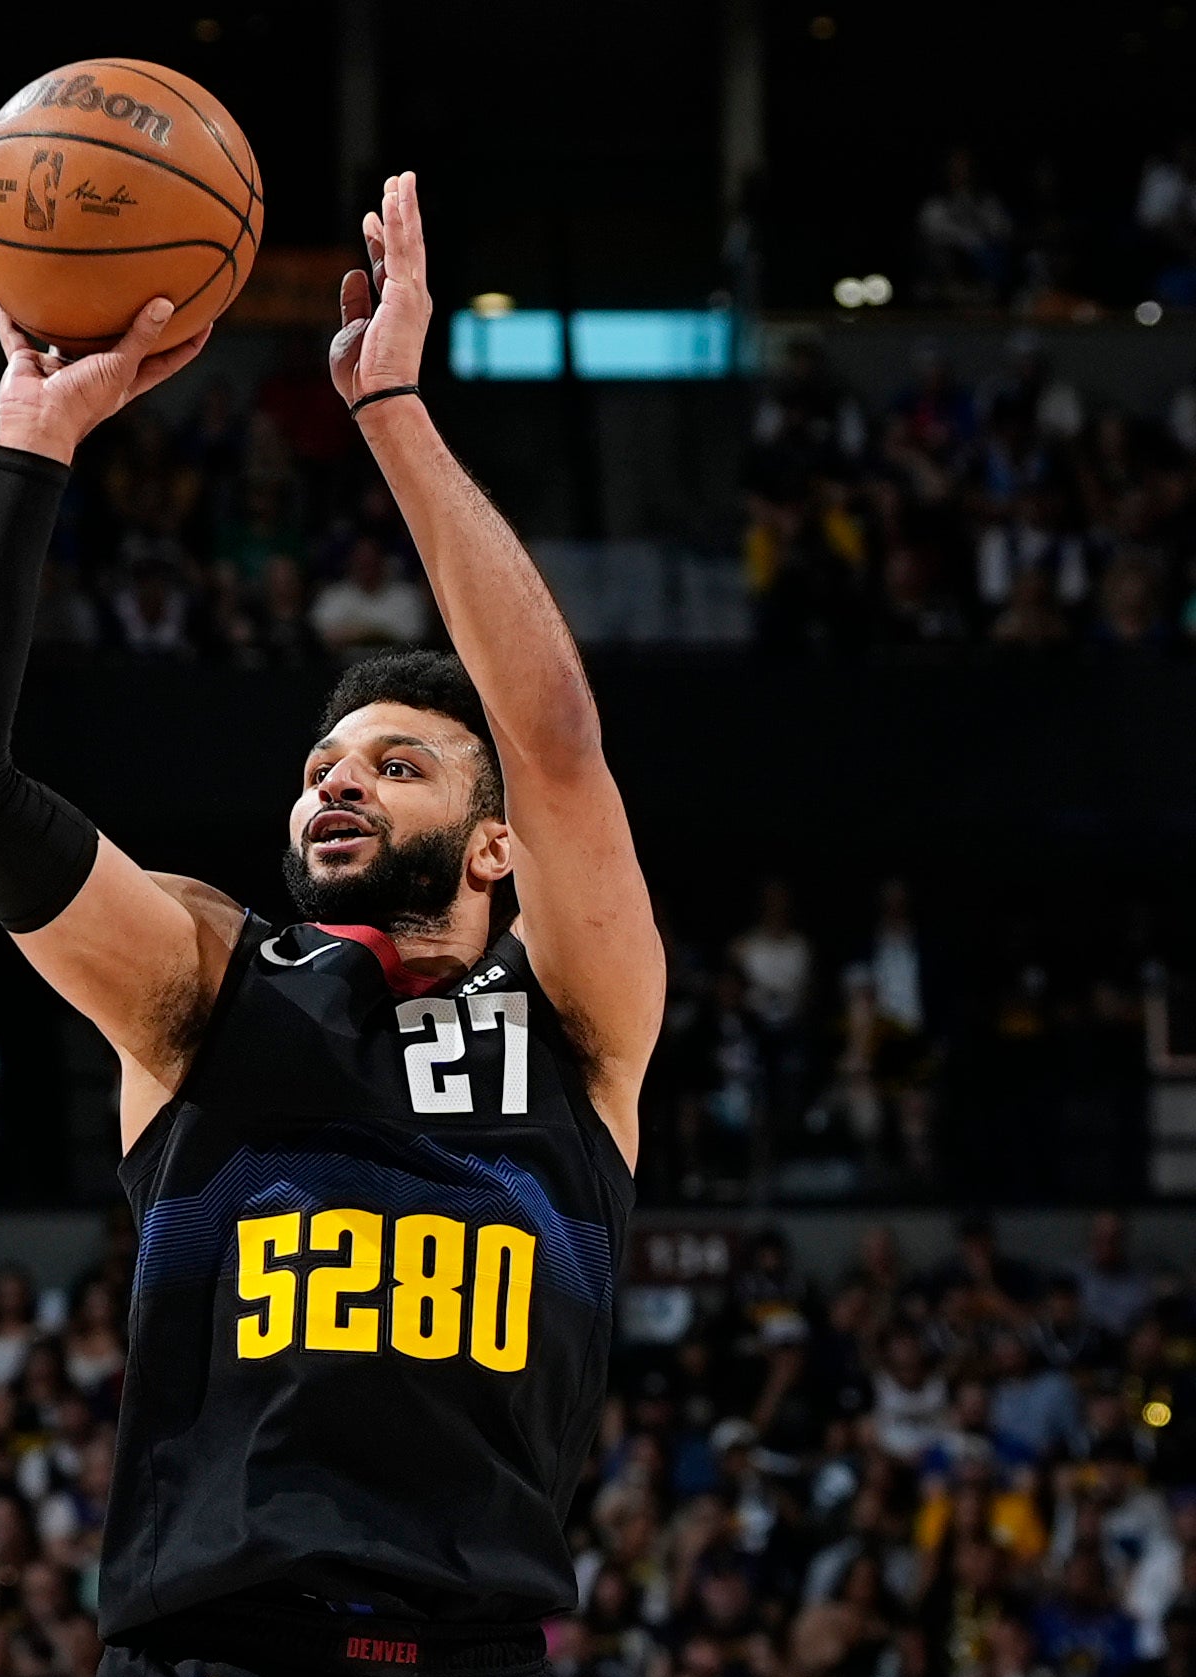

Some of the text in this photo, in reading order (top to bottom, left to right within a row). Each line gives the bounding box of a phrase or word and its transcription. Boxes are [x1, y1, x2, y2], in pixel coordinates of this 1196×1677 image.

[458, 965, 506, 998] tta
[395, 991, 528, 1115] 27
[237, 1208, 537, 1373] 5280
[346, 1637, 417, 1664] DENVER
